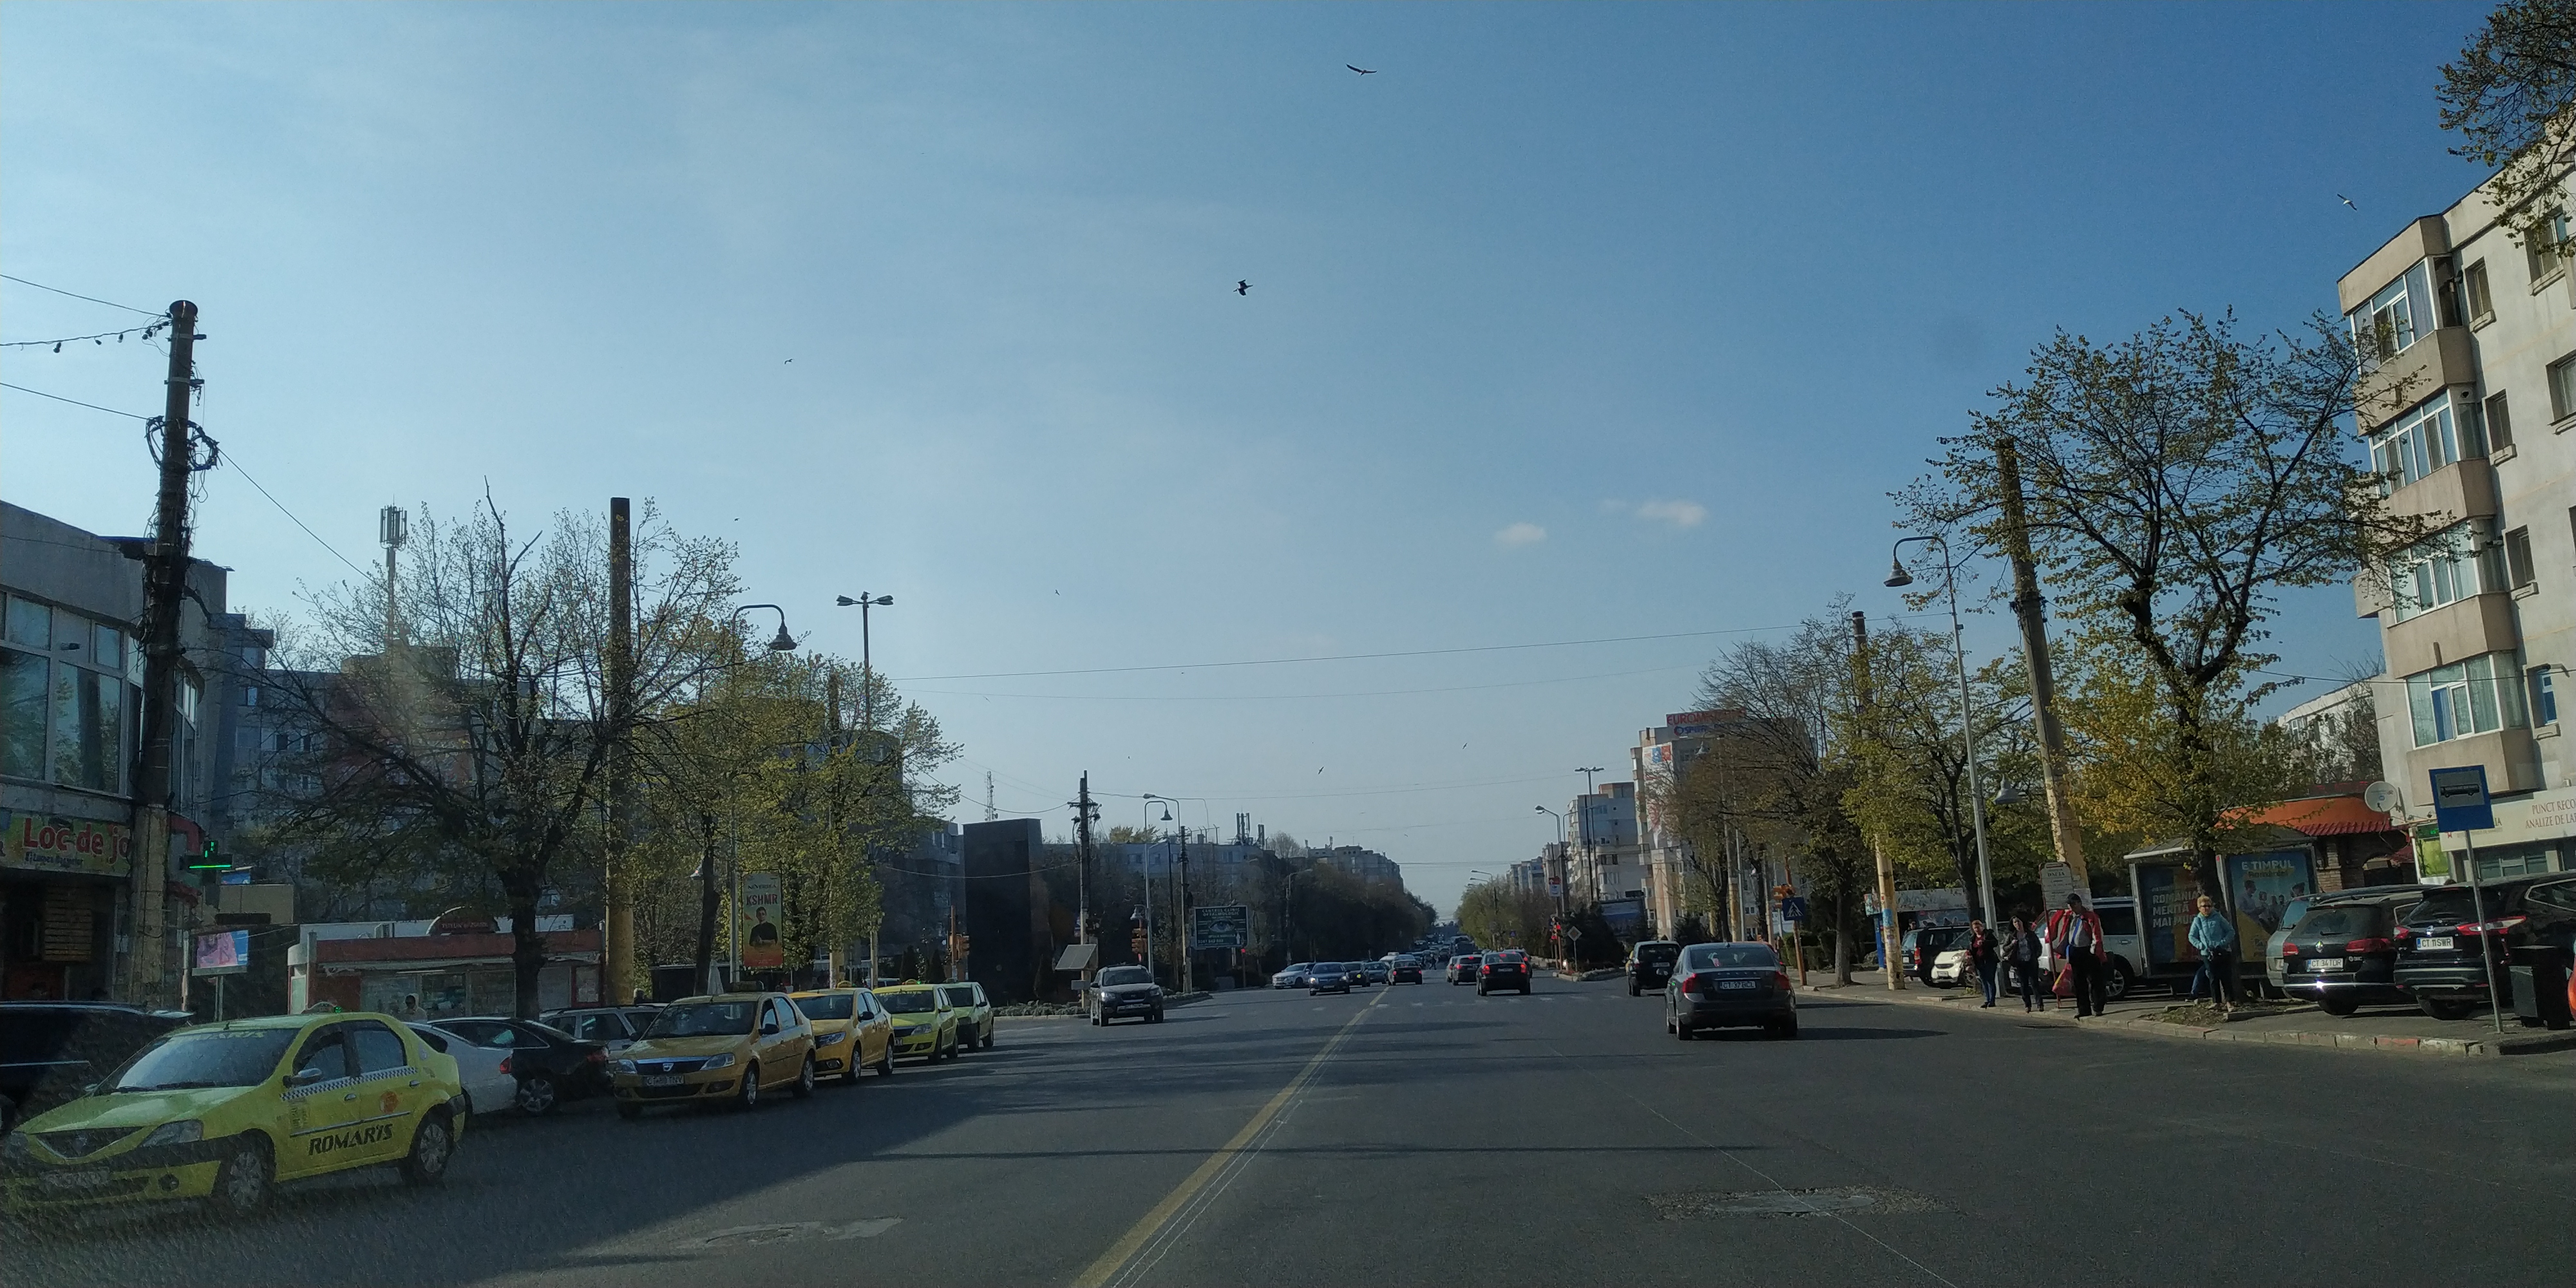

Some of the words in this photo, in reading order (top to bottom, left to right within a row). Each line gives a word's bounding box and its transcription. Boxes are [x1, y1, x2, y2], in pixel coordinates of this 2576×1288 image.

[2532, 802, 2555, 815] PUNCT
[2525, 815, 2554, 829] ANALIZE
[2555, 814, 2564, 826] DE
[24, 817, 70, 851] Loc
[76, 823, 104, 855] de
[2250, 859, 2295, 870] TIMPUL
[746, 893, 778, 905] KSHMR
[2153, 917, 2172, 928] MAI
